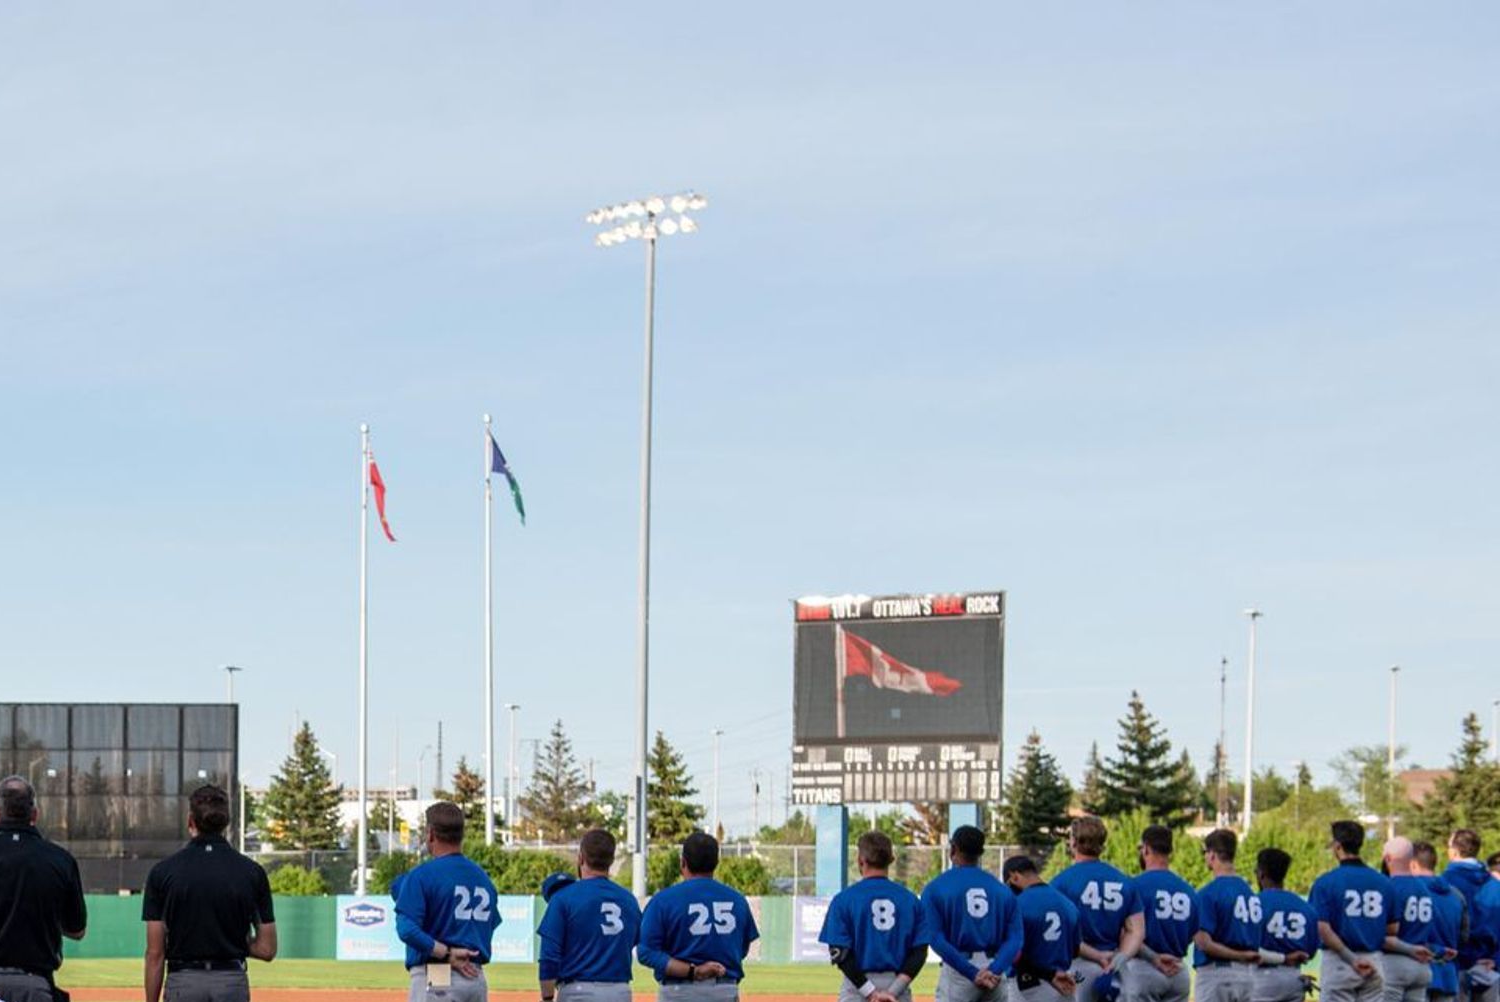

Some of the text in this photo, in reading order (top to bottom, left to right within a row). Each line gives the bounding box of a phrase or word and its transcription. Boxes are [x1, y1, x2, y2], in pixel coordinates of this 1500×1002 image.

[872, 598, 932, 618] OTTAWA'S
[934, 596, 964, 614] REAL
[966, 595, 999, 613] ROCK
[793, 788, 841, 803] TITANS
[454, 885, 491, 921] 22
[965, 888, 989, 918] 6
[1081, 880, 1124, 911] 45
[1154, 890, 1191, 920] 39
[1233, 894, 1262, 923] 46
[1344, 889, 1383, 917] 28
[1404, 895, 1432, 923] 66
[600, 902, 624, 935] 3
[688, 901, 736, 935] 25
[871, 898, 896, 931] 8
[1043, 911, 1061, 941] 2
[1266, 911, 1306, 940] 43
